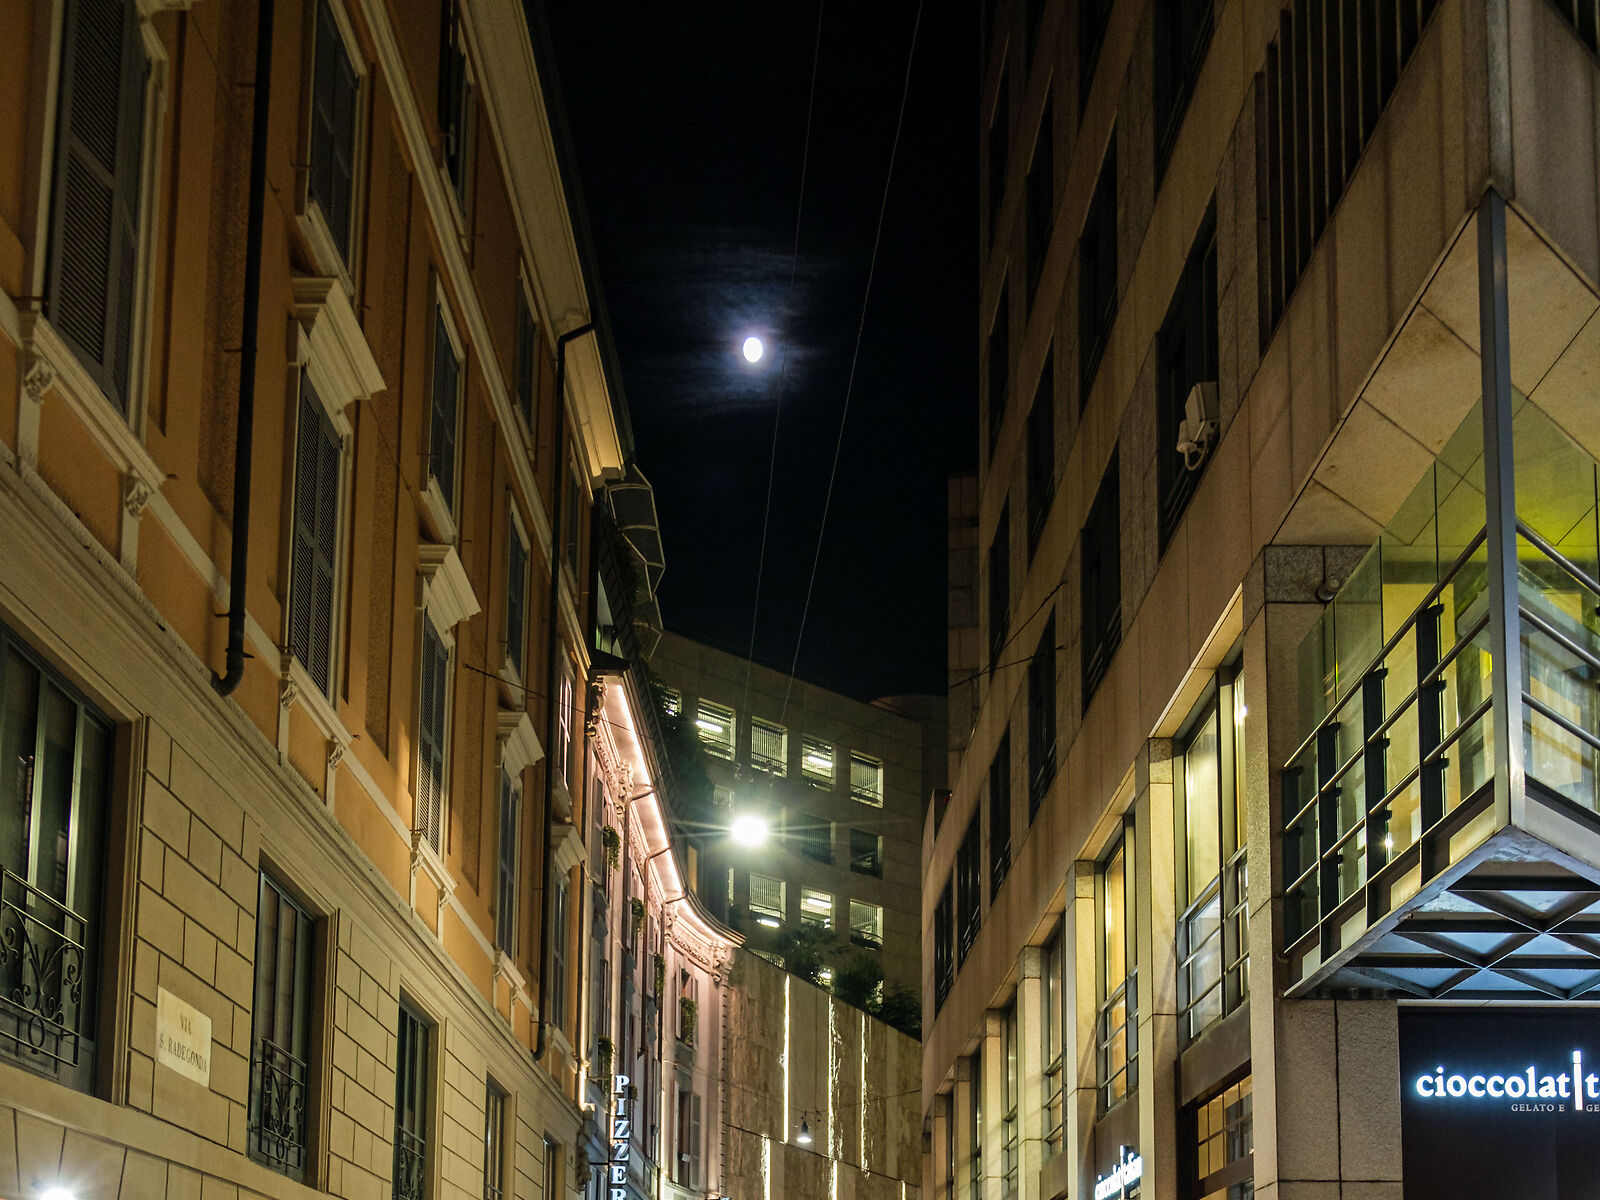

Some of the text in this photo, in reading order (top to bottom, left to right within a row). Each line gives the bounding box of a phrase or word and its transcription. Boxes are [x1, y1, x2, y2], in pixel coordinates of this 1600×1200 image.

[181, 1015, 192, 1035] VIA
[168, 1038, 207, 1072] RADEGONDA
[1511, 1103, 1555, 1112] GELATO
[1558, 1103, 1565, 1112] E
